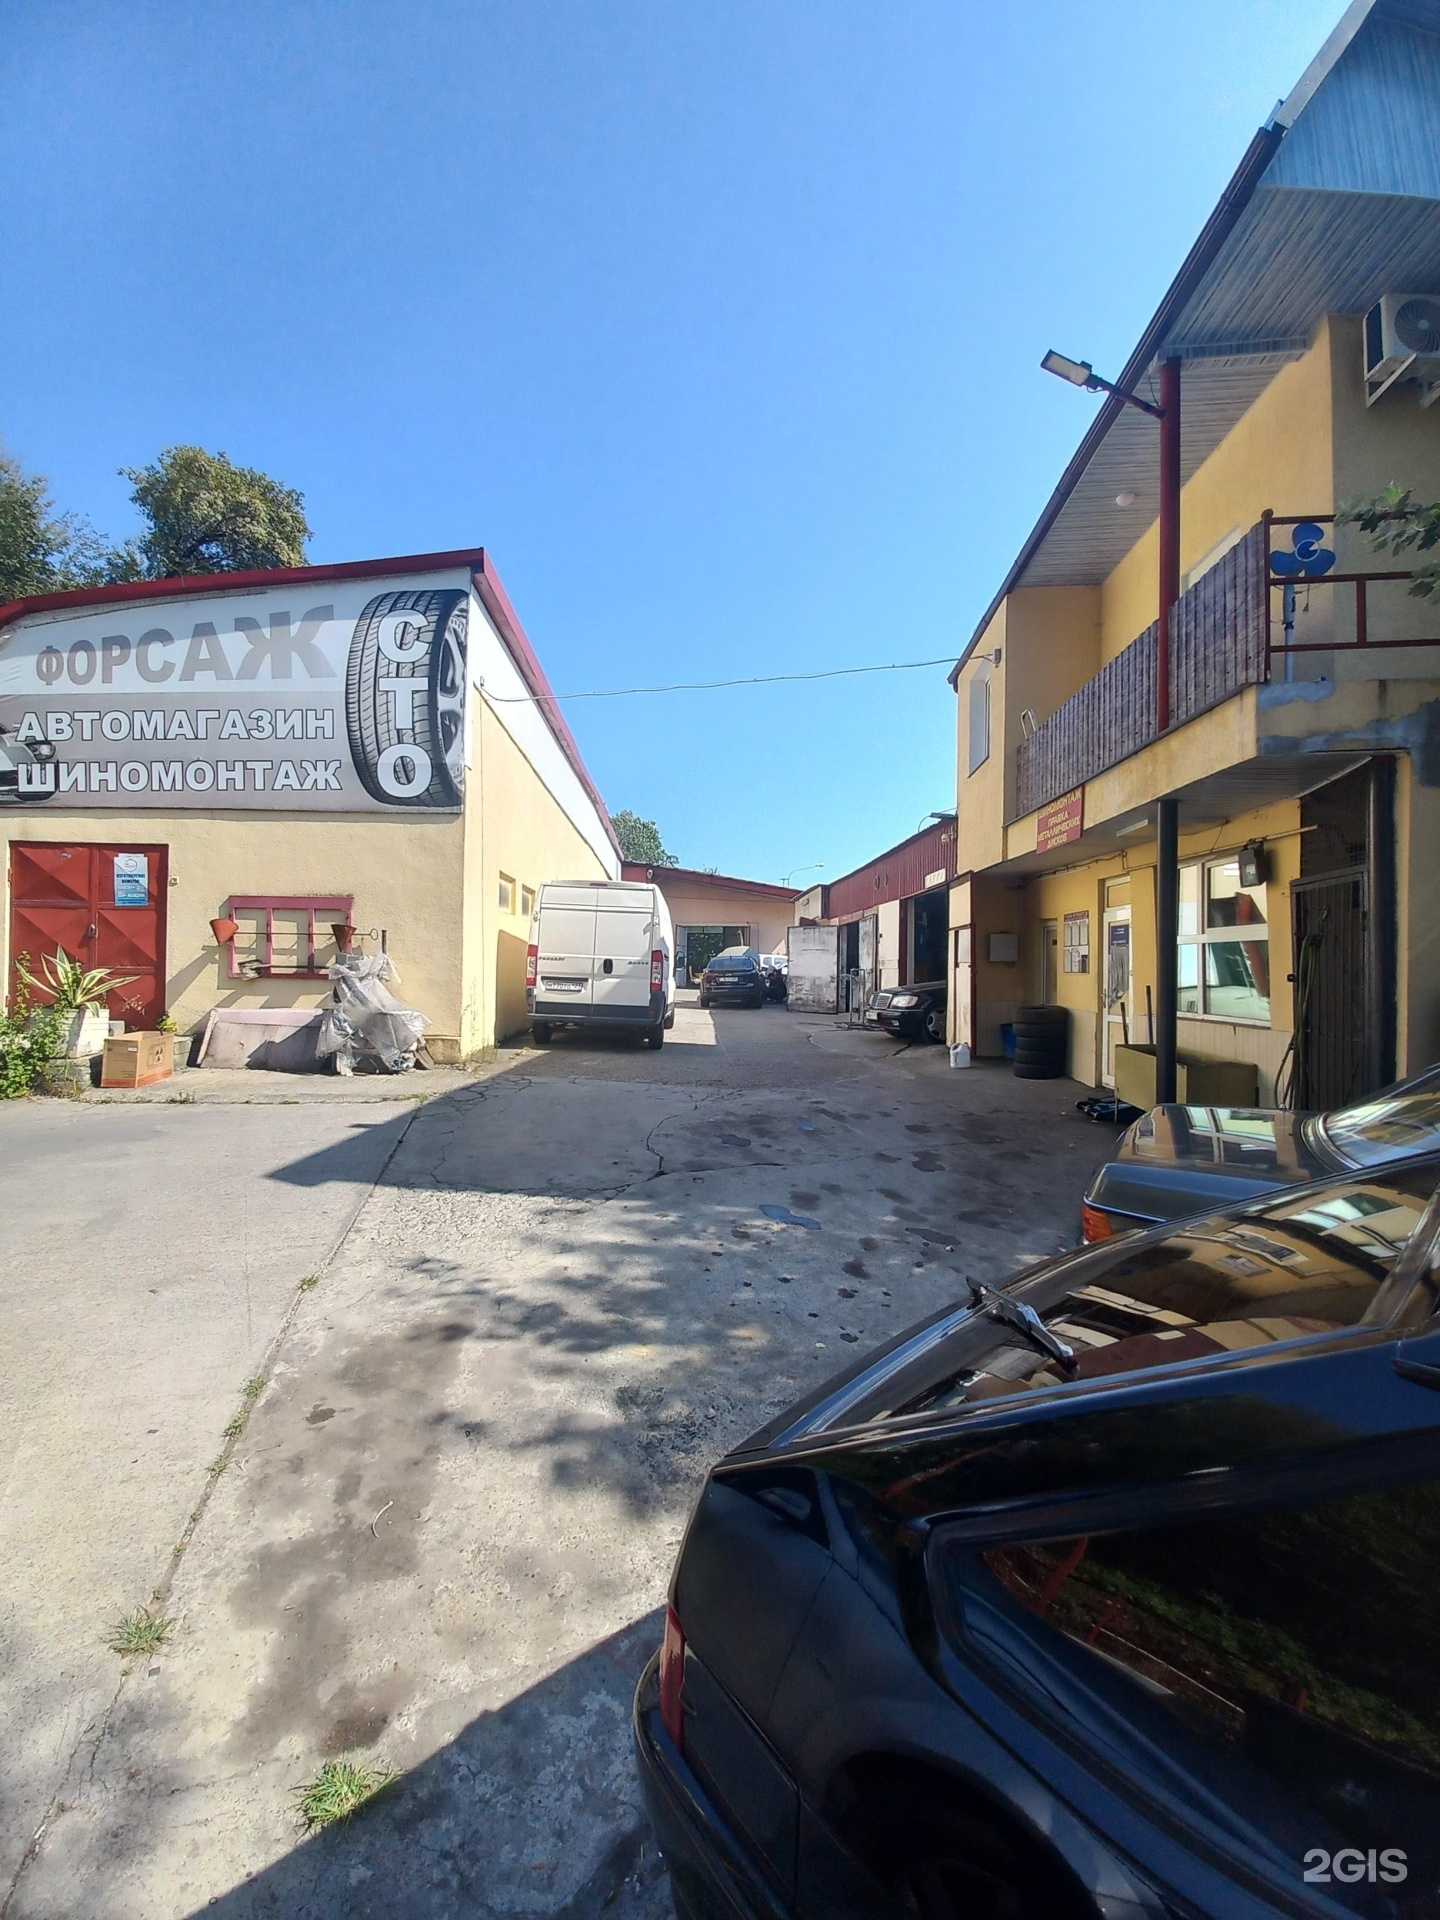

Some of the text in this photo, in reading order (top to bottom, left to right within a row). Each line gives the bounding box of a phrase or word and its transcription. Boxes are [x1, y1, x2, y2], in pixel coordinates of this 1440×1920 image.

[35, 605, 338, 686] ФОРСАЖ
[15, 708, 336, 742] АВТОМАГАЗИН
[376, 608, 434, 798] СТО
[16, 759, 343, 792] ШИНОМОНТАЖ
